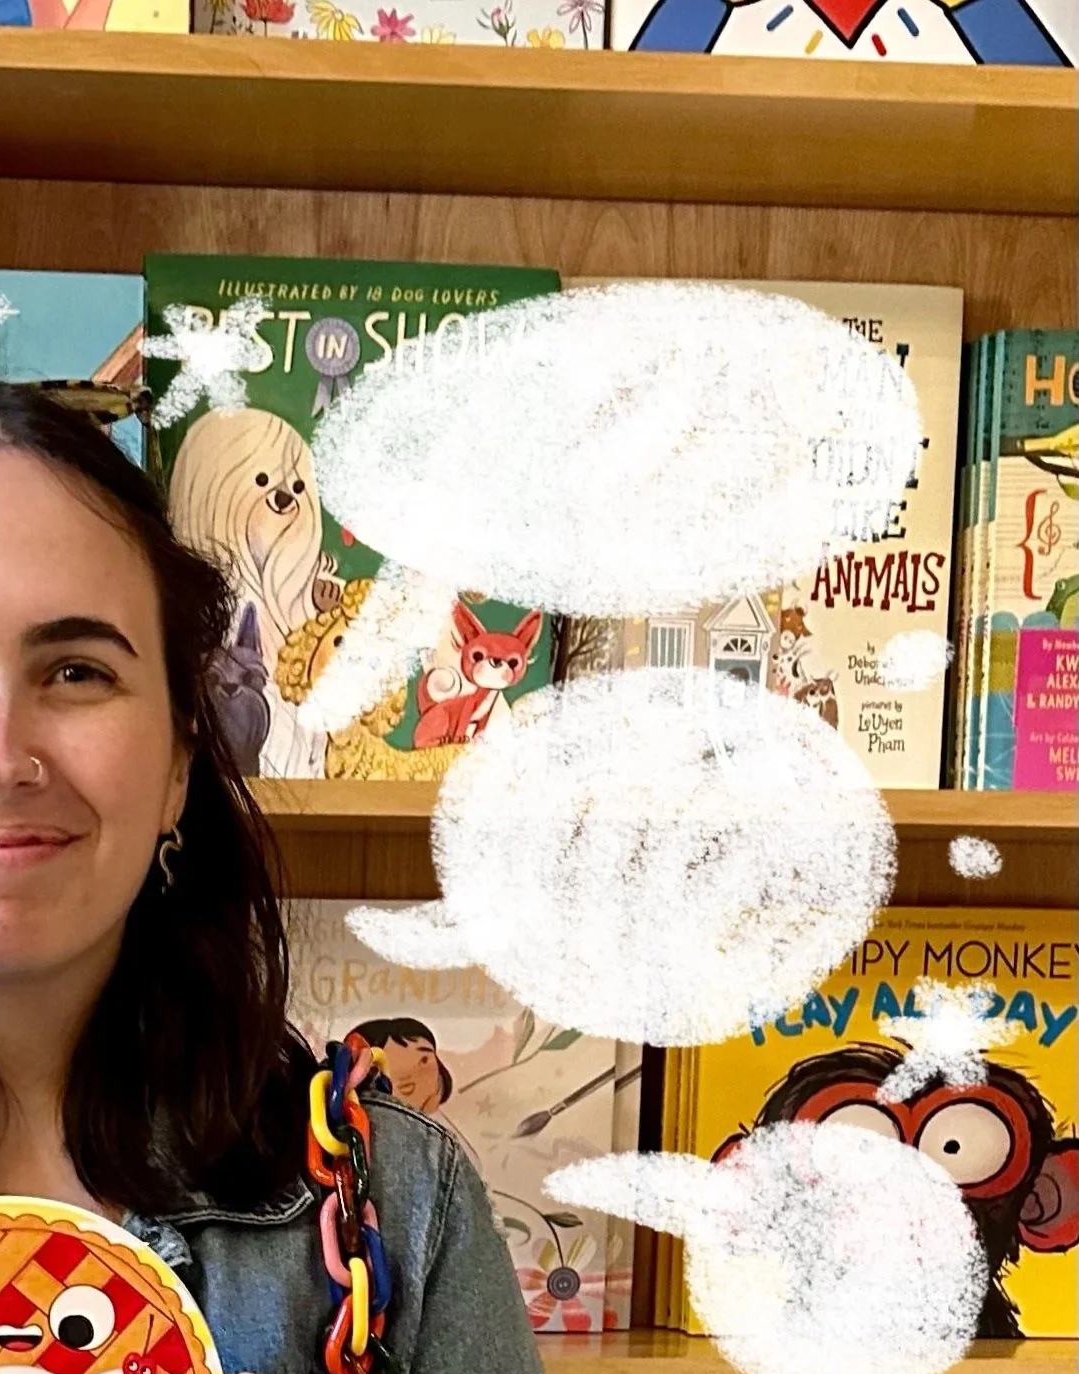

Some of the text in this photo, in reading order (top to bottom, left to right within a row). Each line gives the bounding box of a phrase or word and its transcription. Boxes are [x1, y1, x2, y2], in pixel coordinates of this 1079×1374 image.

[218, 278, 333, 301] ILLUSTRATED
[339, 283, 359, 301] BY
[392, 287, 424, 303] DOG
[433, 288, 500, 306] LOVERS
[184, 304, 312, 375] BST
[318, 333, 347, 359] IN
[811, 550, 946, 612] ANIMALS
[1046, 673, 1079, 689] ALEX
[868, 733, 905, 753] Pham
[923, 940, 1079, 979] MONKE
[872, 981, 940, 1022] AL
